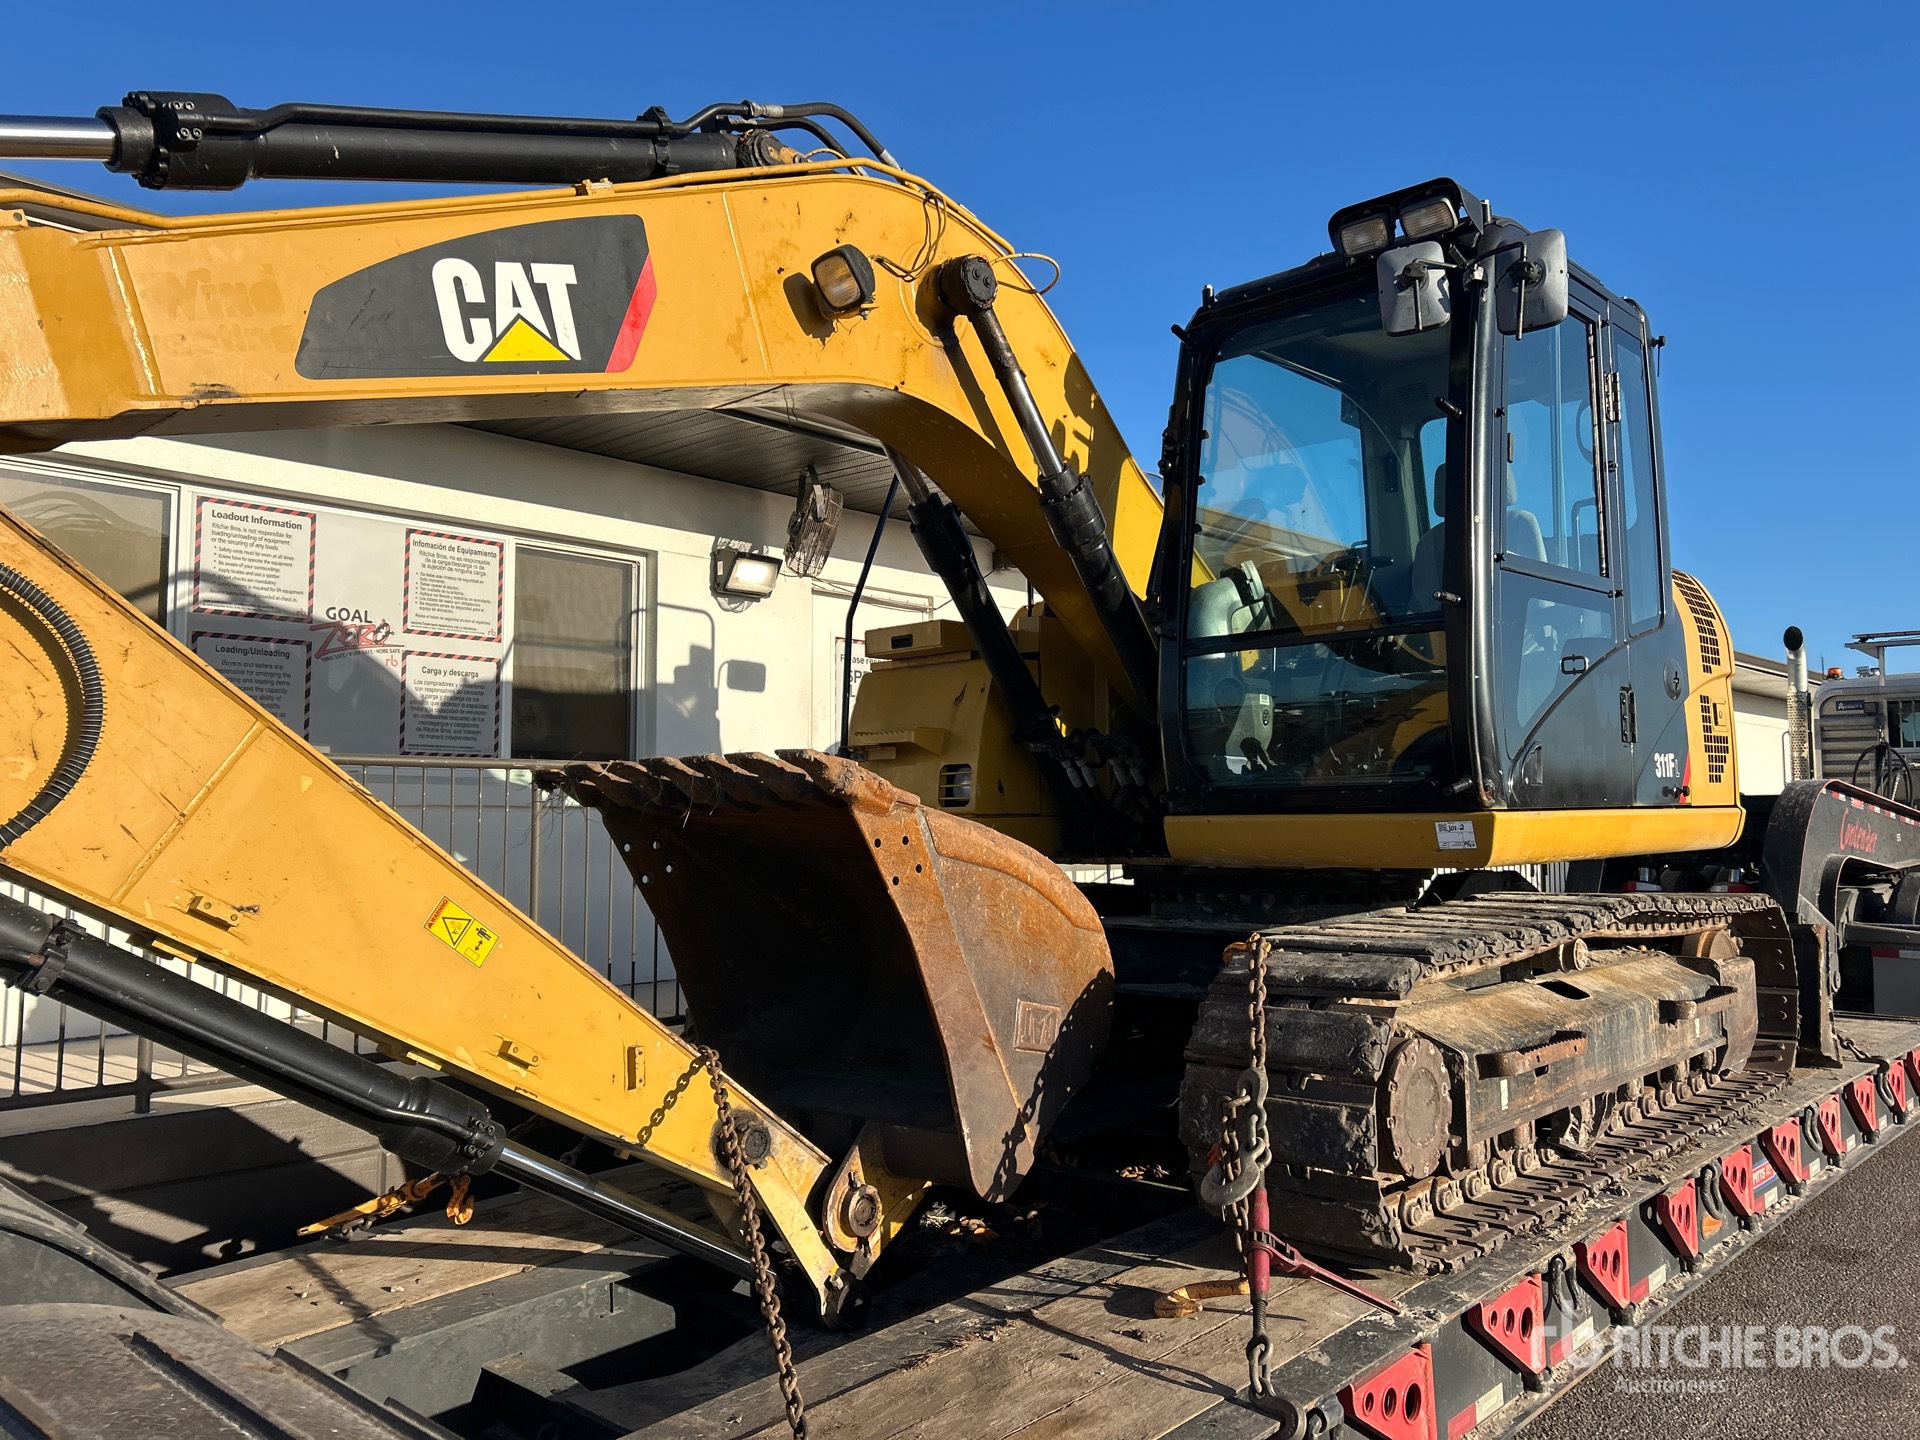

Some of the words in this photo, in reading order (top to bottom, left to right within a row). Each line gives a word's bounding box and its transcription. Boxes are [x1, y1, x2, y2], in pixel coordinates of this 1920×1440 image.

[432, 257, 581, 362] CAT
[212, 509, 249, 523] Loadout
[252, 515, 302, 530] Information
[413, 539, 447, 551] Infomación
[448, 544, 455, 552] de
[457, 546, 497, 560] Equipamiento
[326, 606, 372, 624] GOAL
[215, 644, 291, 660] Loading/Unloading
[840, 654, 865, 664] Pase
[422, 666, 442, 676] Carga
[449, 668, 479, 679] descarga
[430, 900, 449, 922] WARNING
